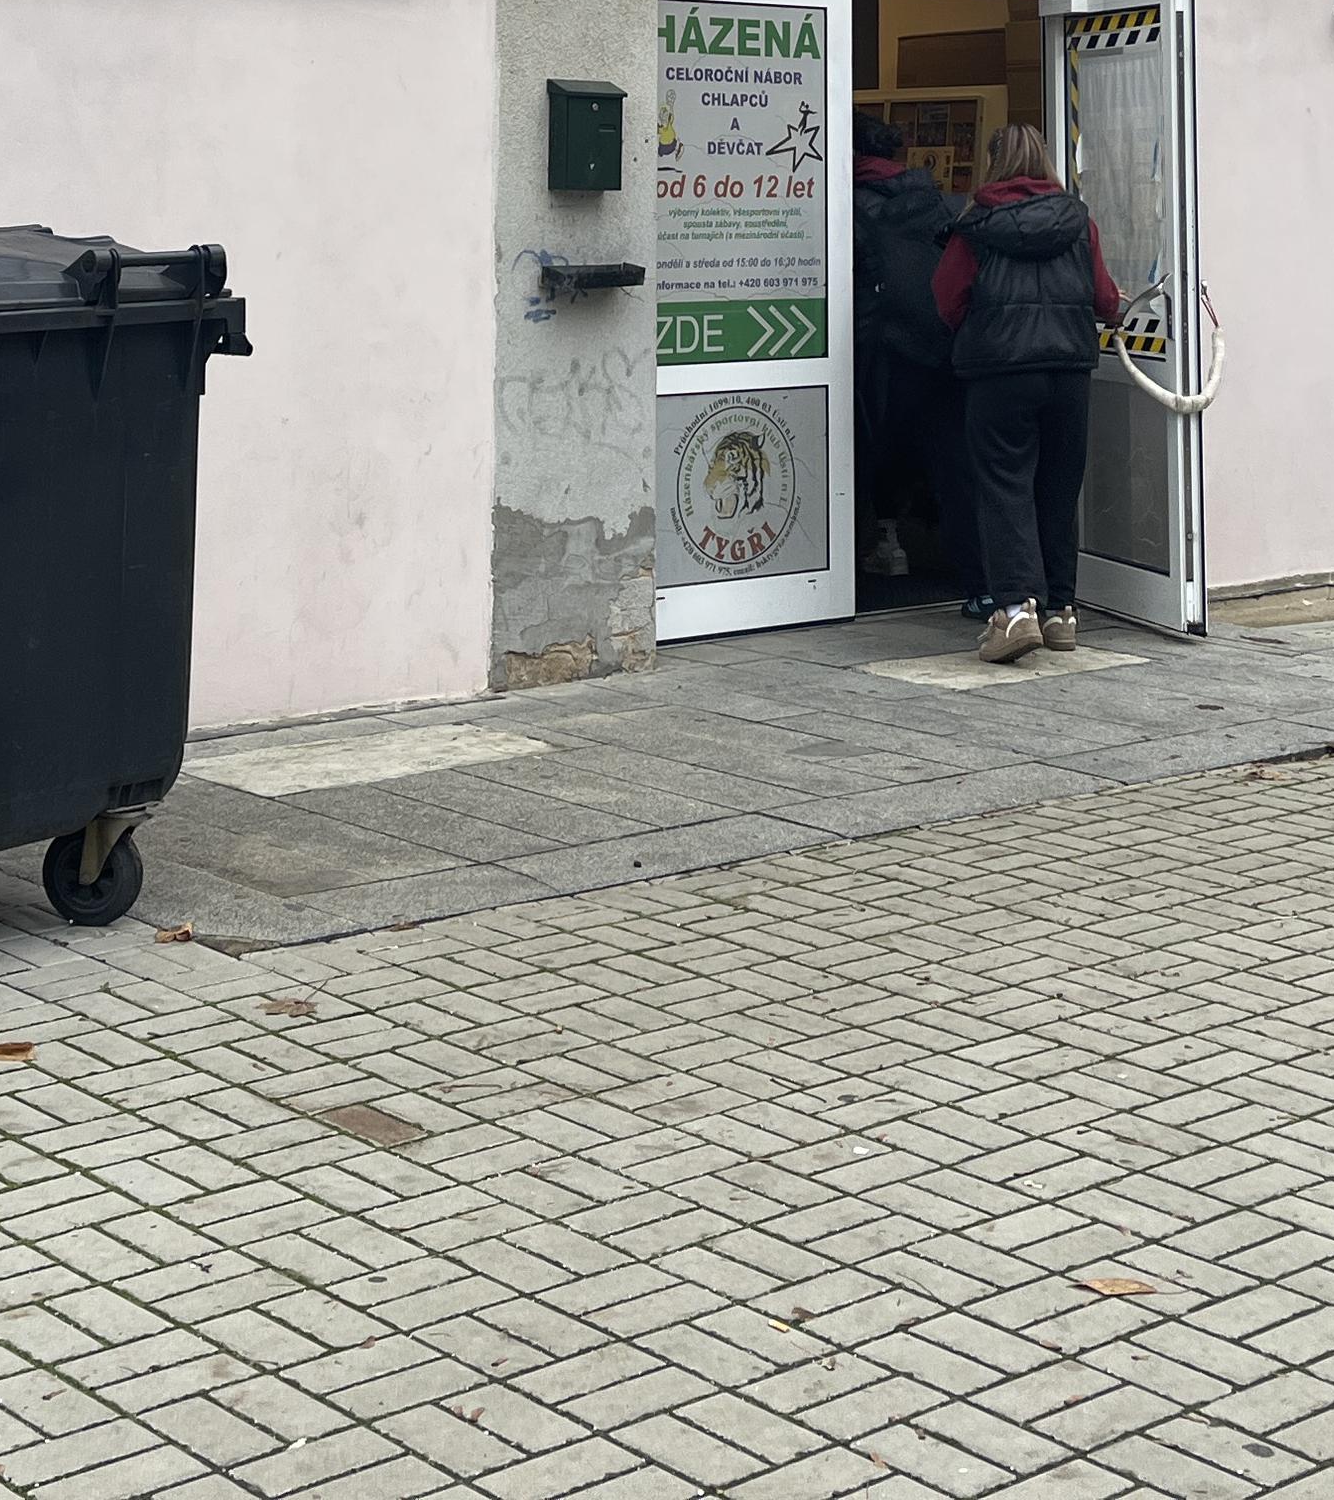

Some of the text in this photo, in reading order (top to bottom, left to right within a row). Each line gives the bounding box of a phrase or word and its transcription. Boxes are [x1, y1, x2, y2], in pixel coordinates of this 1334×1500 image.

[658, 7, 821, 59] HÁZENÁ
[666, 66, 803, 85] CELOROČNÍ NÁBOR
[701, 90, 768, 107] CHLAPCŮ
[730, 117, 740, 131] A
[708, 138, 763, 155] DĚVČAT
[657, 174, 815, 198] od 6 do 12 let
[656, 258, 684, 269] ondělí
[722, 258, 734, 268] od
[760, 257, 771, 267] do
[797, 256, 821, 267] hodin
[656, 280, 701, 290] nformace
[703, 281, 715, 289] na
[738, 278, 761, 288] +420
[782, 277, 798, 287] 971
[801, 277, 818, 287] 975
[657, 314, 724, 354] ZDE
[699, 521, 776, 561] TYGŘI
